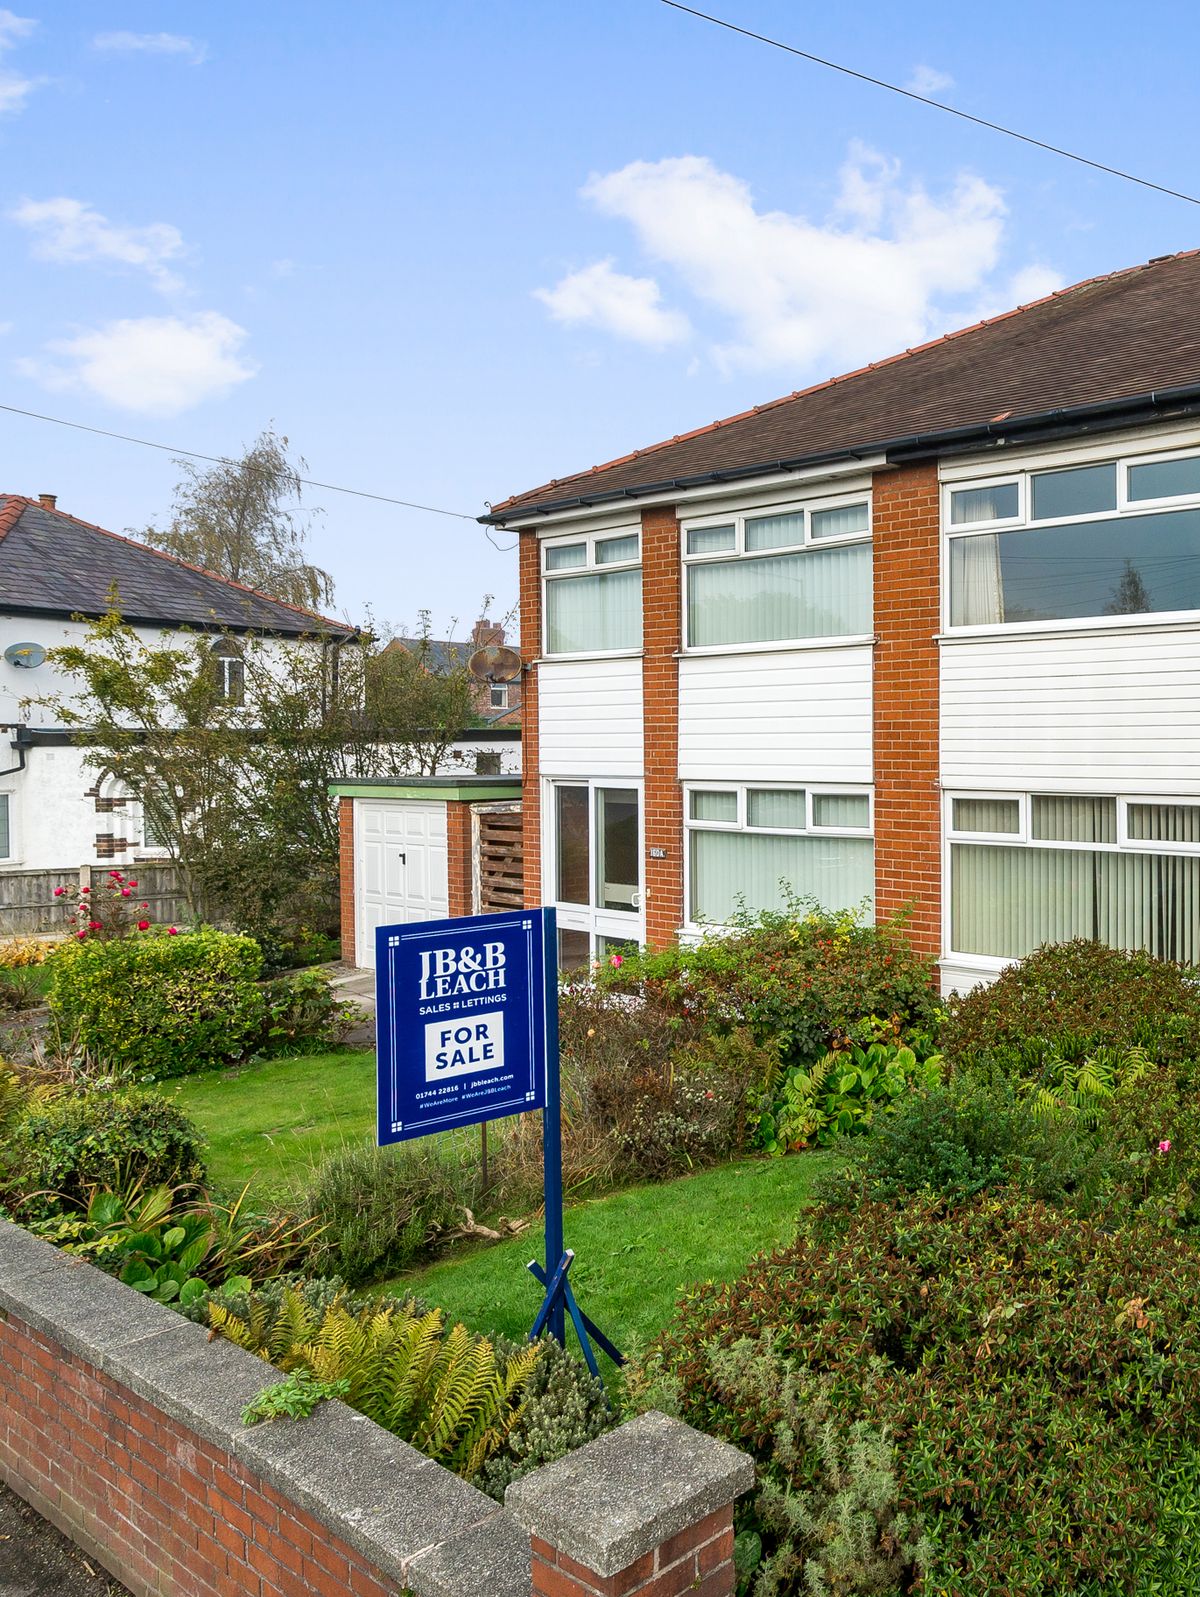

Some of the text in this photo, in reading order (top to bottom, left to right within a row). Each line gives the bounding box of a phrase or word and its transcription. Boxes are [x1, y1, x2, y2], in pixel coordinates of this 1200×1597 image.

[419, 942, 506, 983] JB&B
[419, 967, 507, 1000] LEACH
[419, 993, 507, 1015] SALES LETTINGS
[440, 1023, 490, 1048] FOR
[435, 1042, 494, 1070] SALE
[415, 1074, 514, 1100] 01744 22816 jbbleach.com
